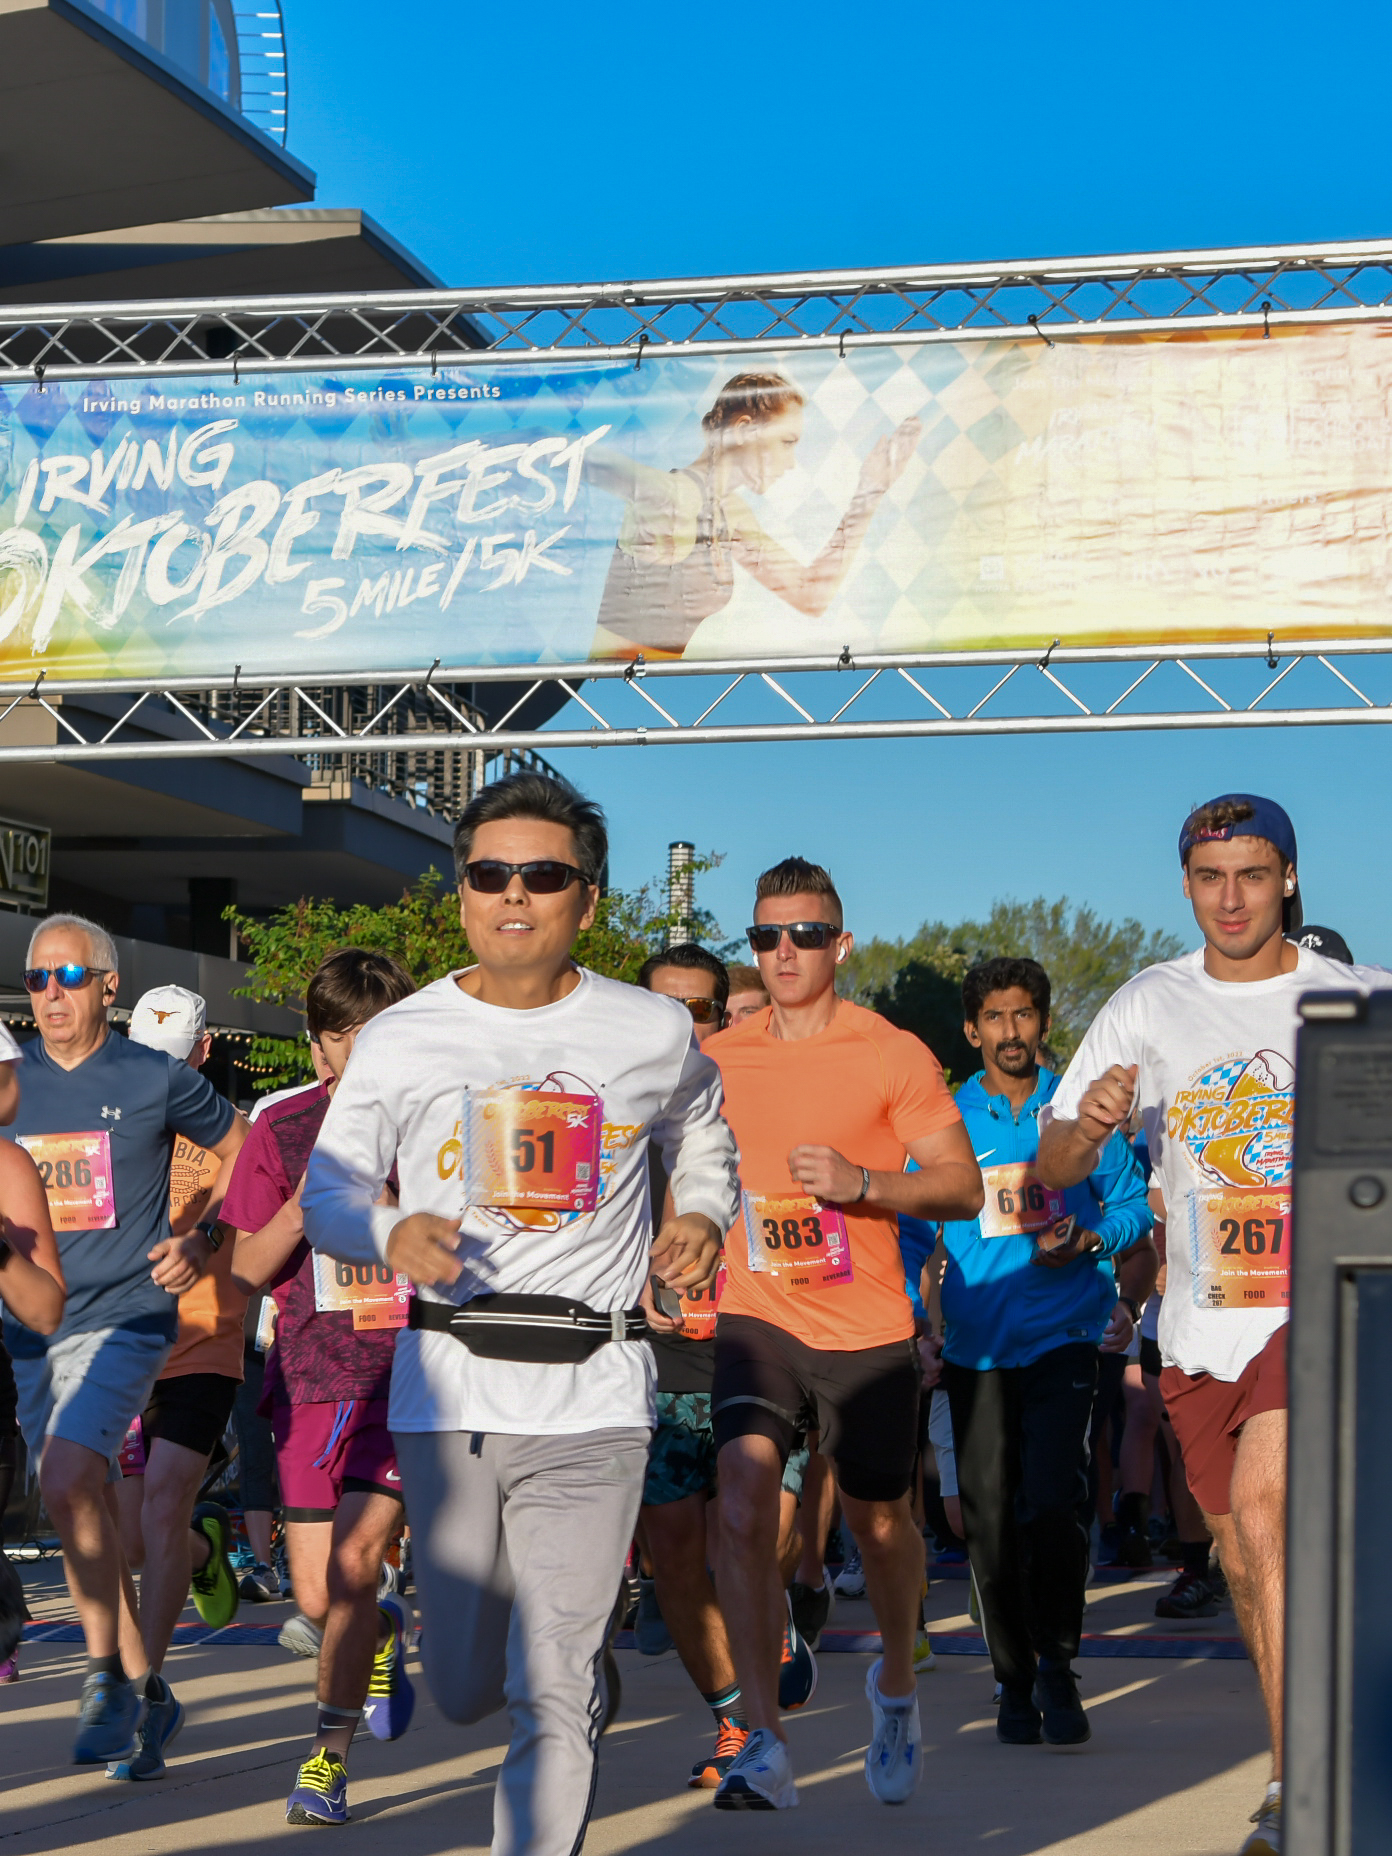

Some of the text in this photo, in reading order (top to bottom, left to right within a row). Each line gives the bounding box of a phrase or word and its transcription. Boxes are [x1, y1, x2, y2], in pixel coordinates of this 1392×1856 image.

[83, 383, 501, 415] Irving Marathon Running Series Presents
[14, 418, 239, 528] IRVING
[293, 576, 349, 641] 5
[1175, 1085, 1227, 1105] IRVING
[565, 1113, 591, 1129] 5K
[511, 1128, 555, 1174] 51
[38, 1158, 92, 1190] 286
[527, 1191, 570, 1201] Movement
[997, 1183, 1045, 1216] 616
[762, 1216, 824, 1250] 383
[1219, 1218, 1284, 1255] 267
[793, 1257, 827, 1267] Movement
[790, 1277, 810, 1286] FOOD
[1243, 1290, 1266, 1299] FOOD
[358, 1314, 377, 1322] FOOD
